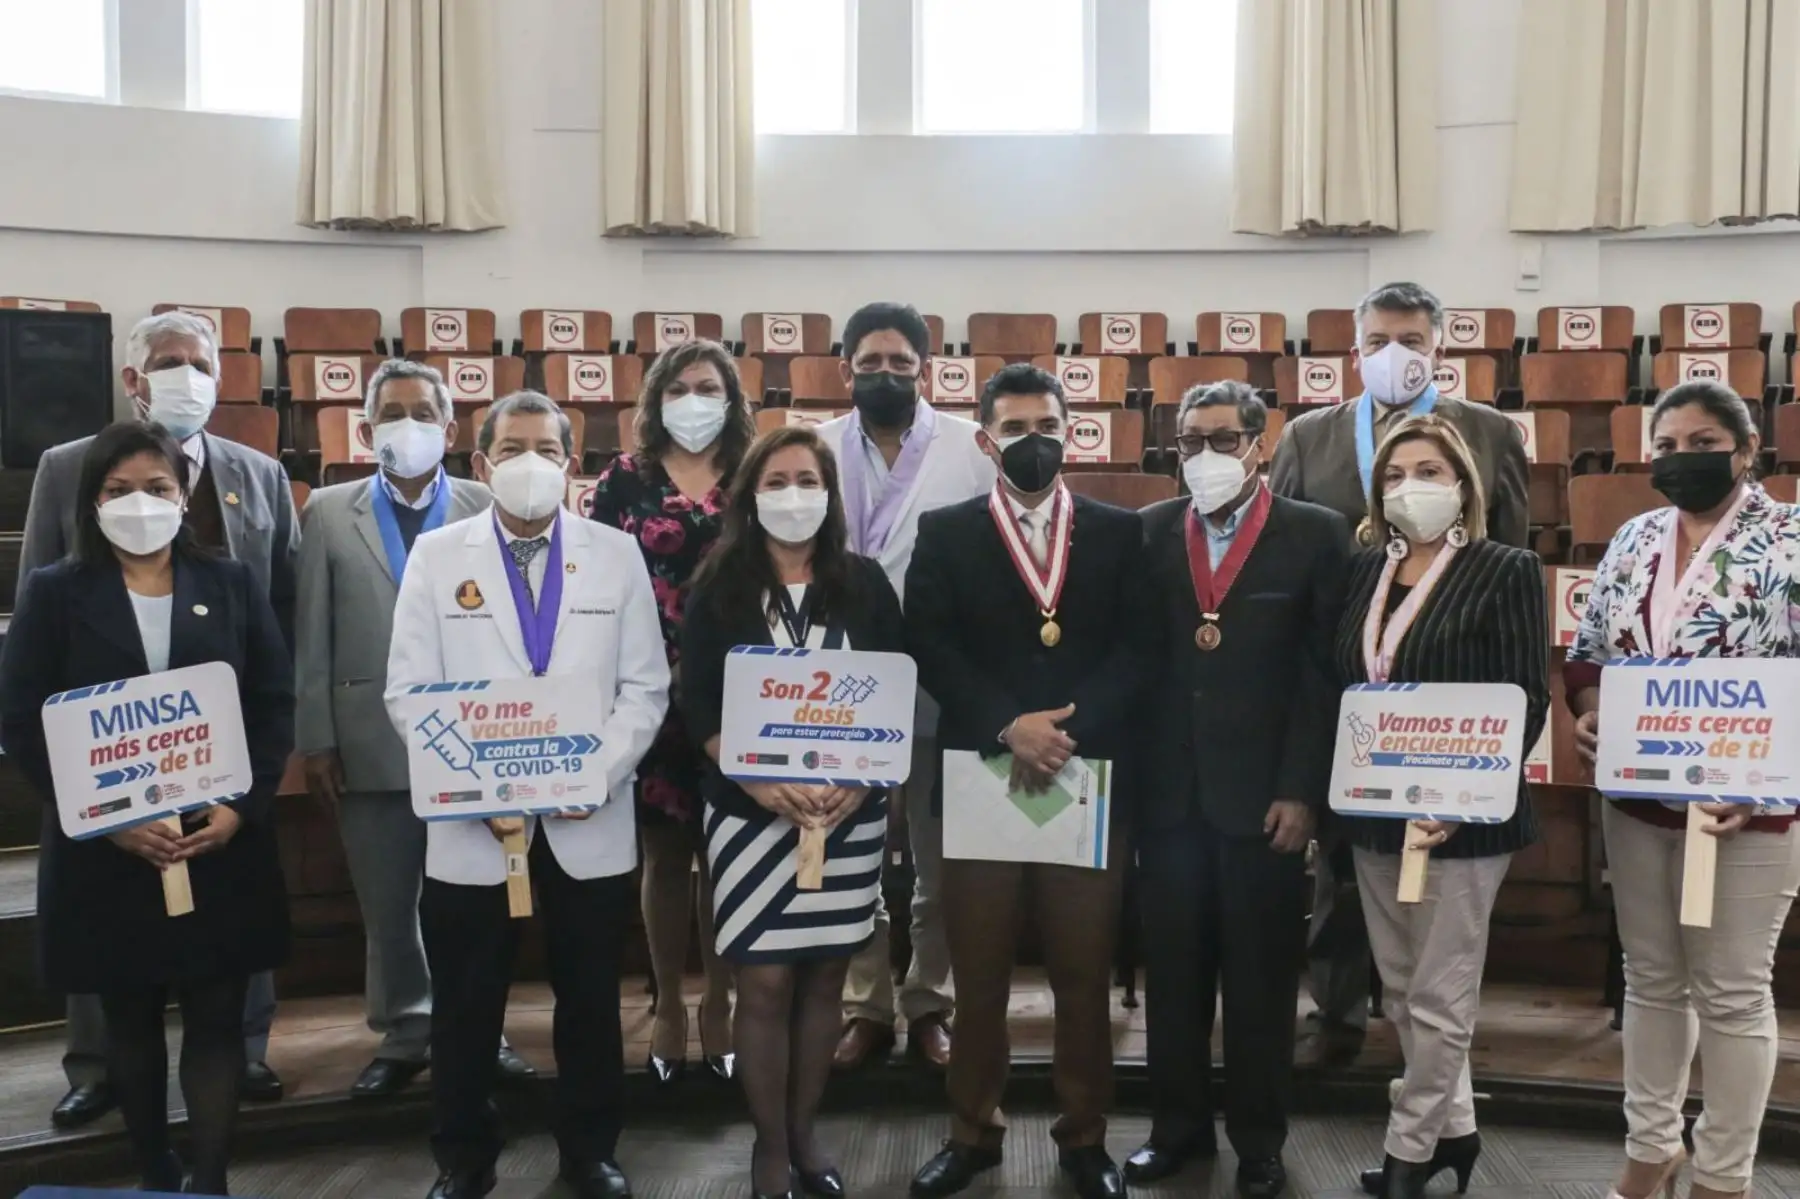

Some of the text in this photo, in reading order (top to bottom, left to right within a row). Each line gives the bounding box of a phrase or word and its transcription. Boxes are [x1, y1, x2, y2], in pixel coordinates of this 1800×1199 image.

[760, 671, 832, 701] Son 2
[1646, 679, 1767, 709] MINSA
[89, 689, 202, 739] MINSA
[459, 701, 533, 721] Yo me
[793, 702, 855, 725] dosis
[1636, 710, 1773, 735] más cerca
[471, 713, 558, 740] vacuné
[770, 726, 866, 740] para estar protegido
[1378, 712, 1508, 735] Vamos a tu
[89, 722, 210, 766] más cerca
[484, 741, 559, 759] contra la
[1379, 734, 1502, 755] encuentro
[1707, 736, 1742, 759] de
[159, 750, 189, 774] de
[494, 756, 583, 778] COVID-19
